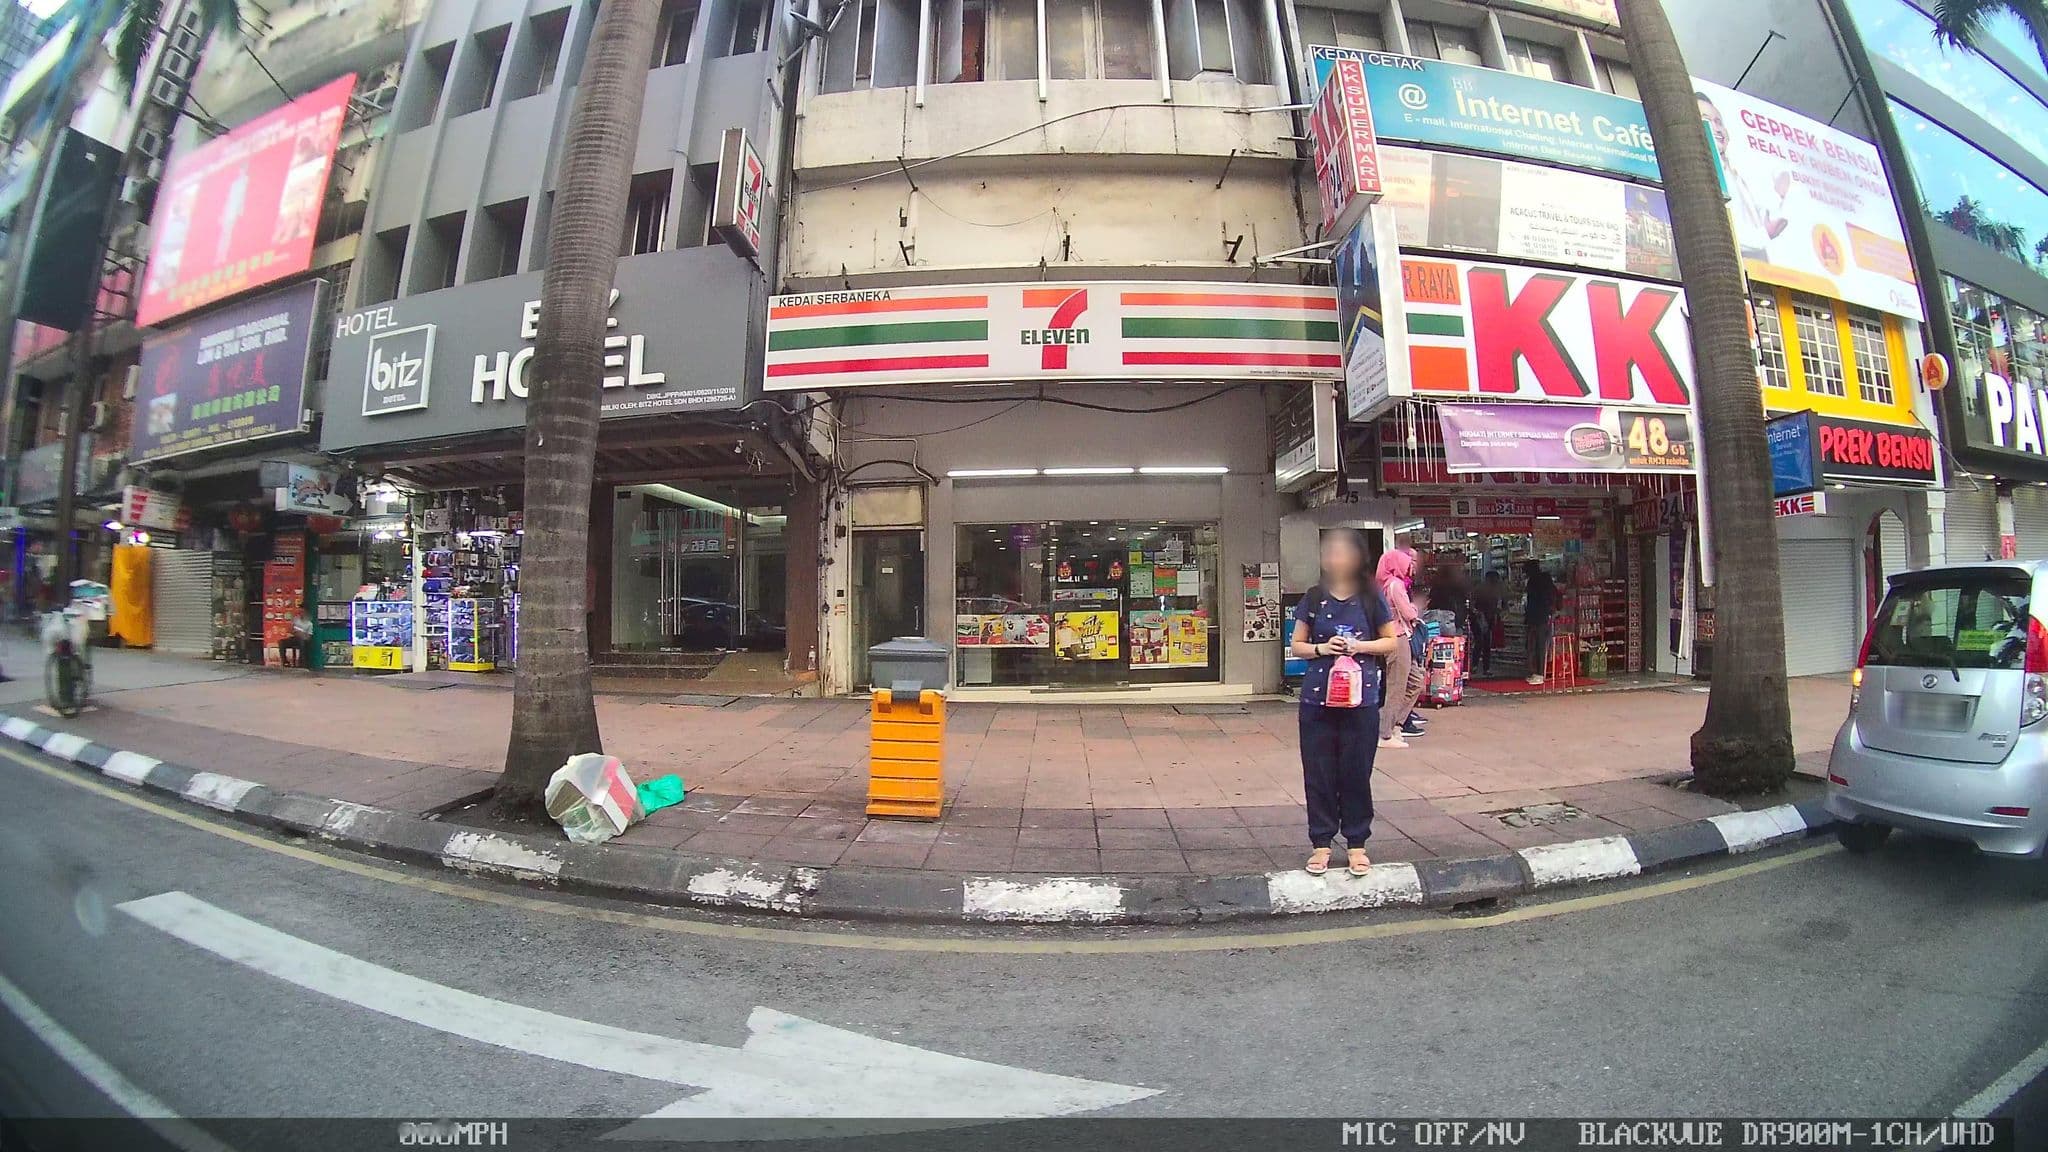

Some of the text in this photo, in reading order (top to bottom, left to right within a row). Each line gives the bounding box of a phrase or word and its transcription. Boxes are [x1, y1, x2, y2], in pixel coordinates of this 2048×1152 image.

[1368, 53, 1425, 72] CETAK
[1455, 90, 1654, 151] Internet Café
[1747, 135, 1787, 160] REAL
[780, 290, 892, 307] KEDAI SERBANEKA
[1417, 265, 1457, 300] RAYA
[336, 306, 398, 338] HOTEL
[1023, 289, 1088, 370] 7
[1467, 266, 1690, 405] KK
[371, 347, 423, 391] bitz
[471, 334, 666, 404] HOEL
[1628, 416, 1669, 457] 48
[1670, 444, 1686, 456] GB
[1818, 425, 1934, 472] PREK BENSU
[1496, 503, 1513, 515] 24
[1779, 497, 1802, 516] KK
